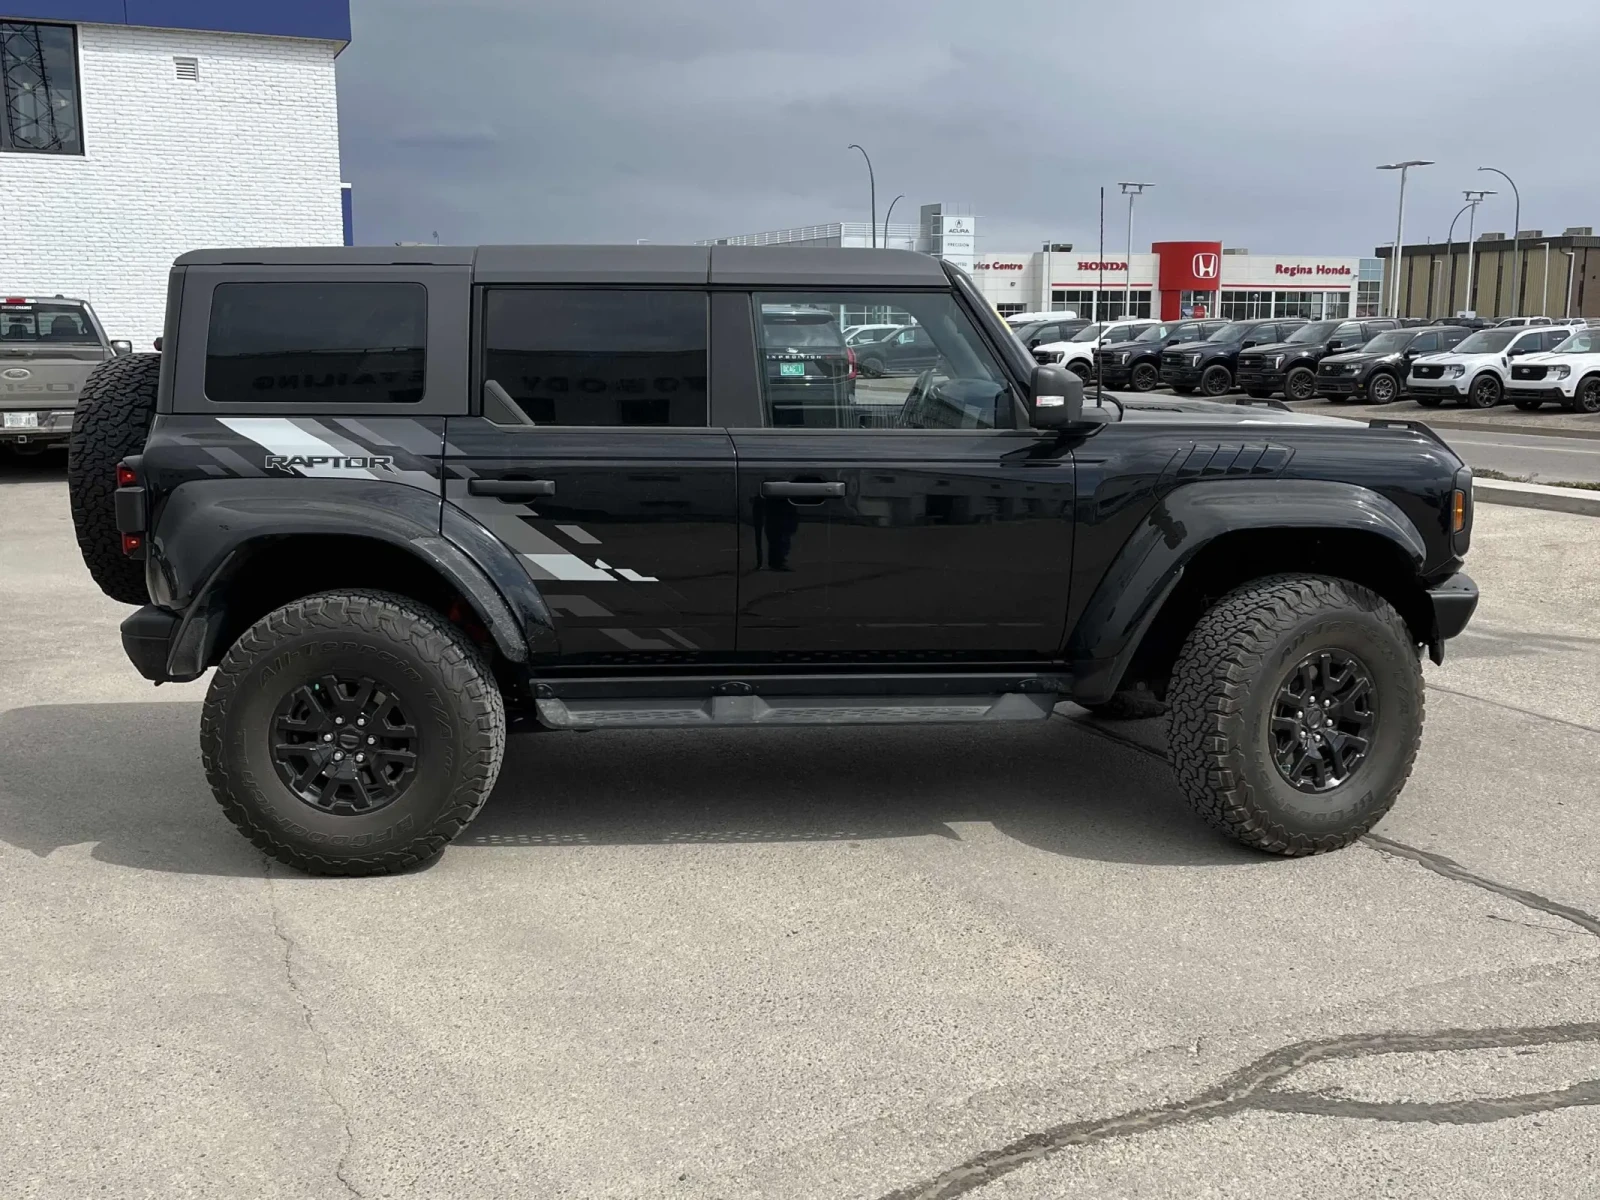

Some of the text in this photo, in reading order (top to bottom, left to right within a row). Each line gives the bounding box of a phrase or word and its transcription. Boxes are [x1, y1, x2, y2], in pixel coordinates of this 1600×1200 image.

[974, 262, 990, 270] vice
[992, 262, 1023, 270] Centre
[1077, 261, 1128, 271] HONDA
[1275, 264, 1351, 277] Regina Honda
[265, 455, 398, 476] RAPTOR
